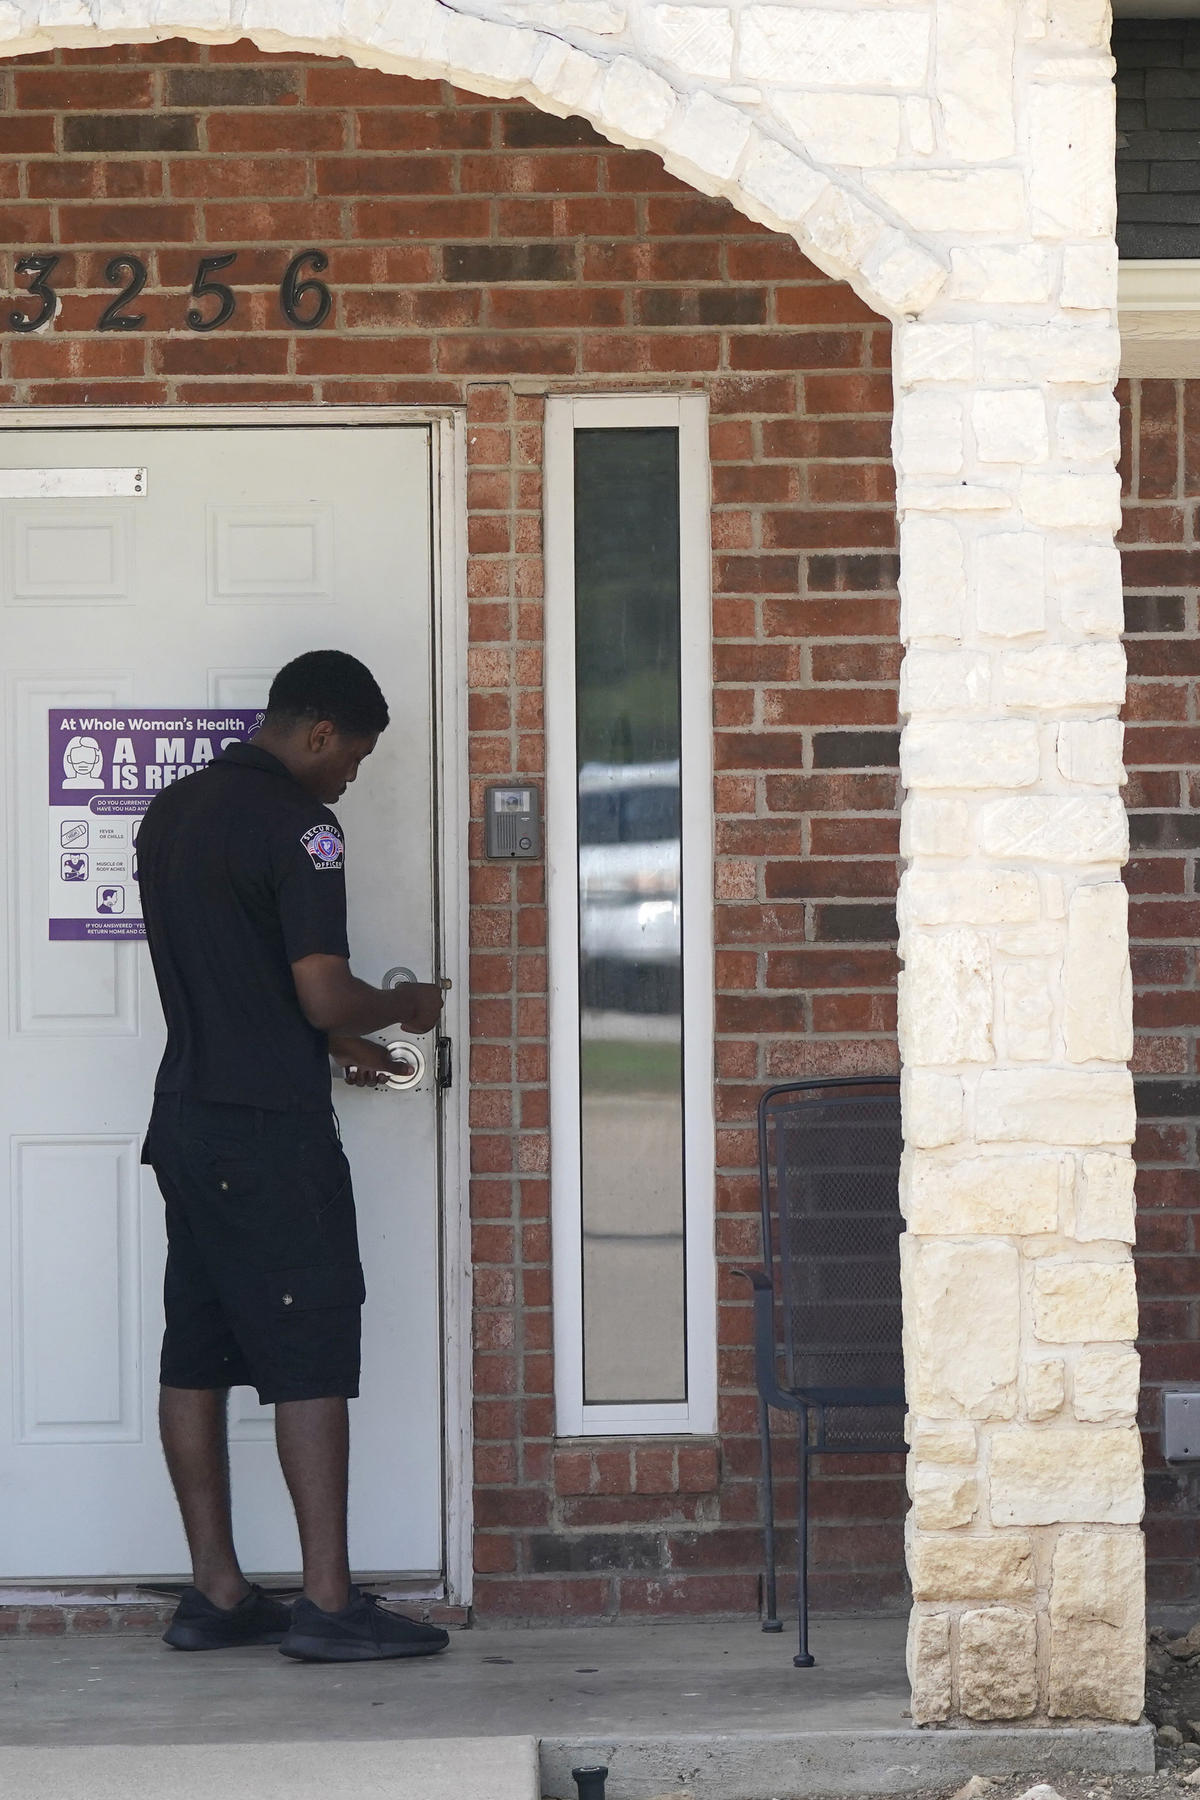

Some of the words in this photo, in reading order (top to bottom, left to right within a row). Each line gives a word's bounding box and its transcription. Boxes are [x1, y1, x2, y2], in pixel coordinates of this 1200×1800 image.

[8, 249, 333, 332] 3256
[60, 718, 76, 731] At
[79, 718, 125, 731] Whole
[128, 717, 193, 731] Woman's
[197, 718, 245, 731] Health
[112, 737, 136, 763] A
[112, 765, 138, 790] IS
[304, 825, 341, 840] SECURITY
